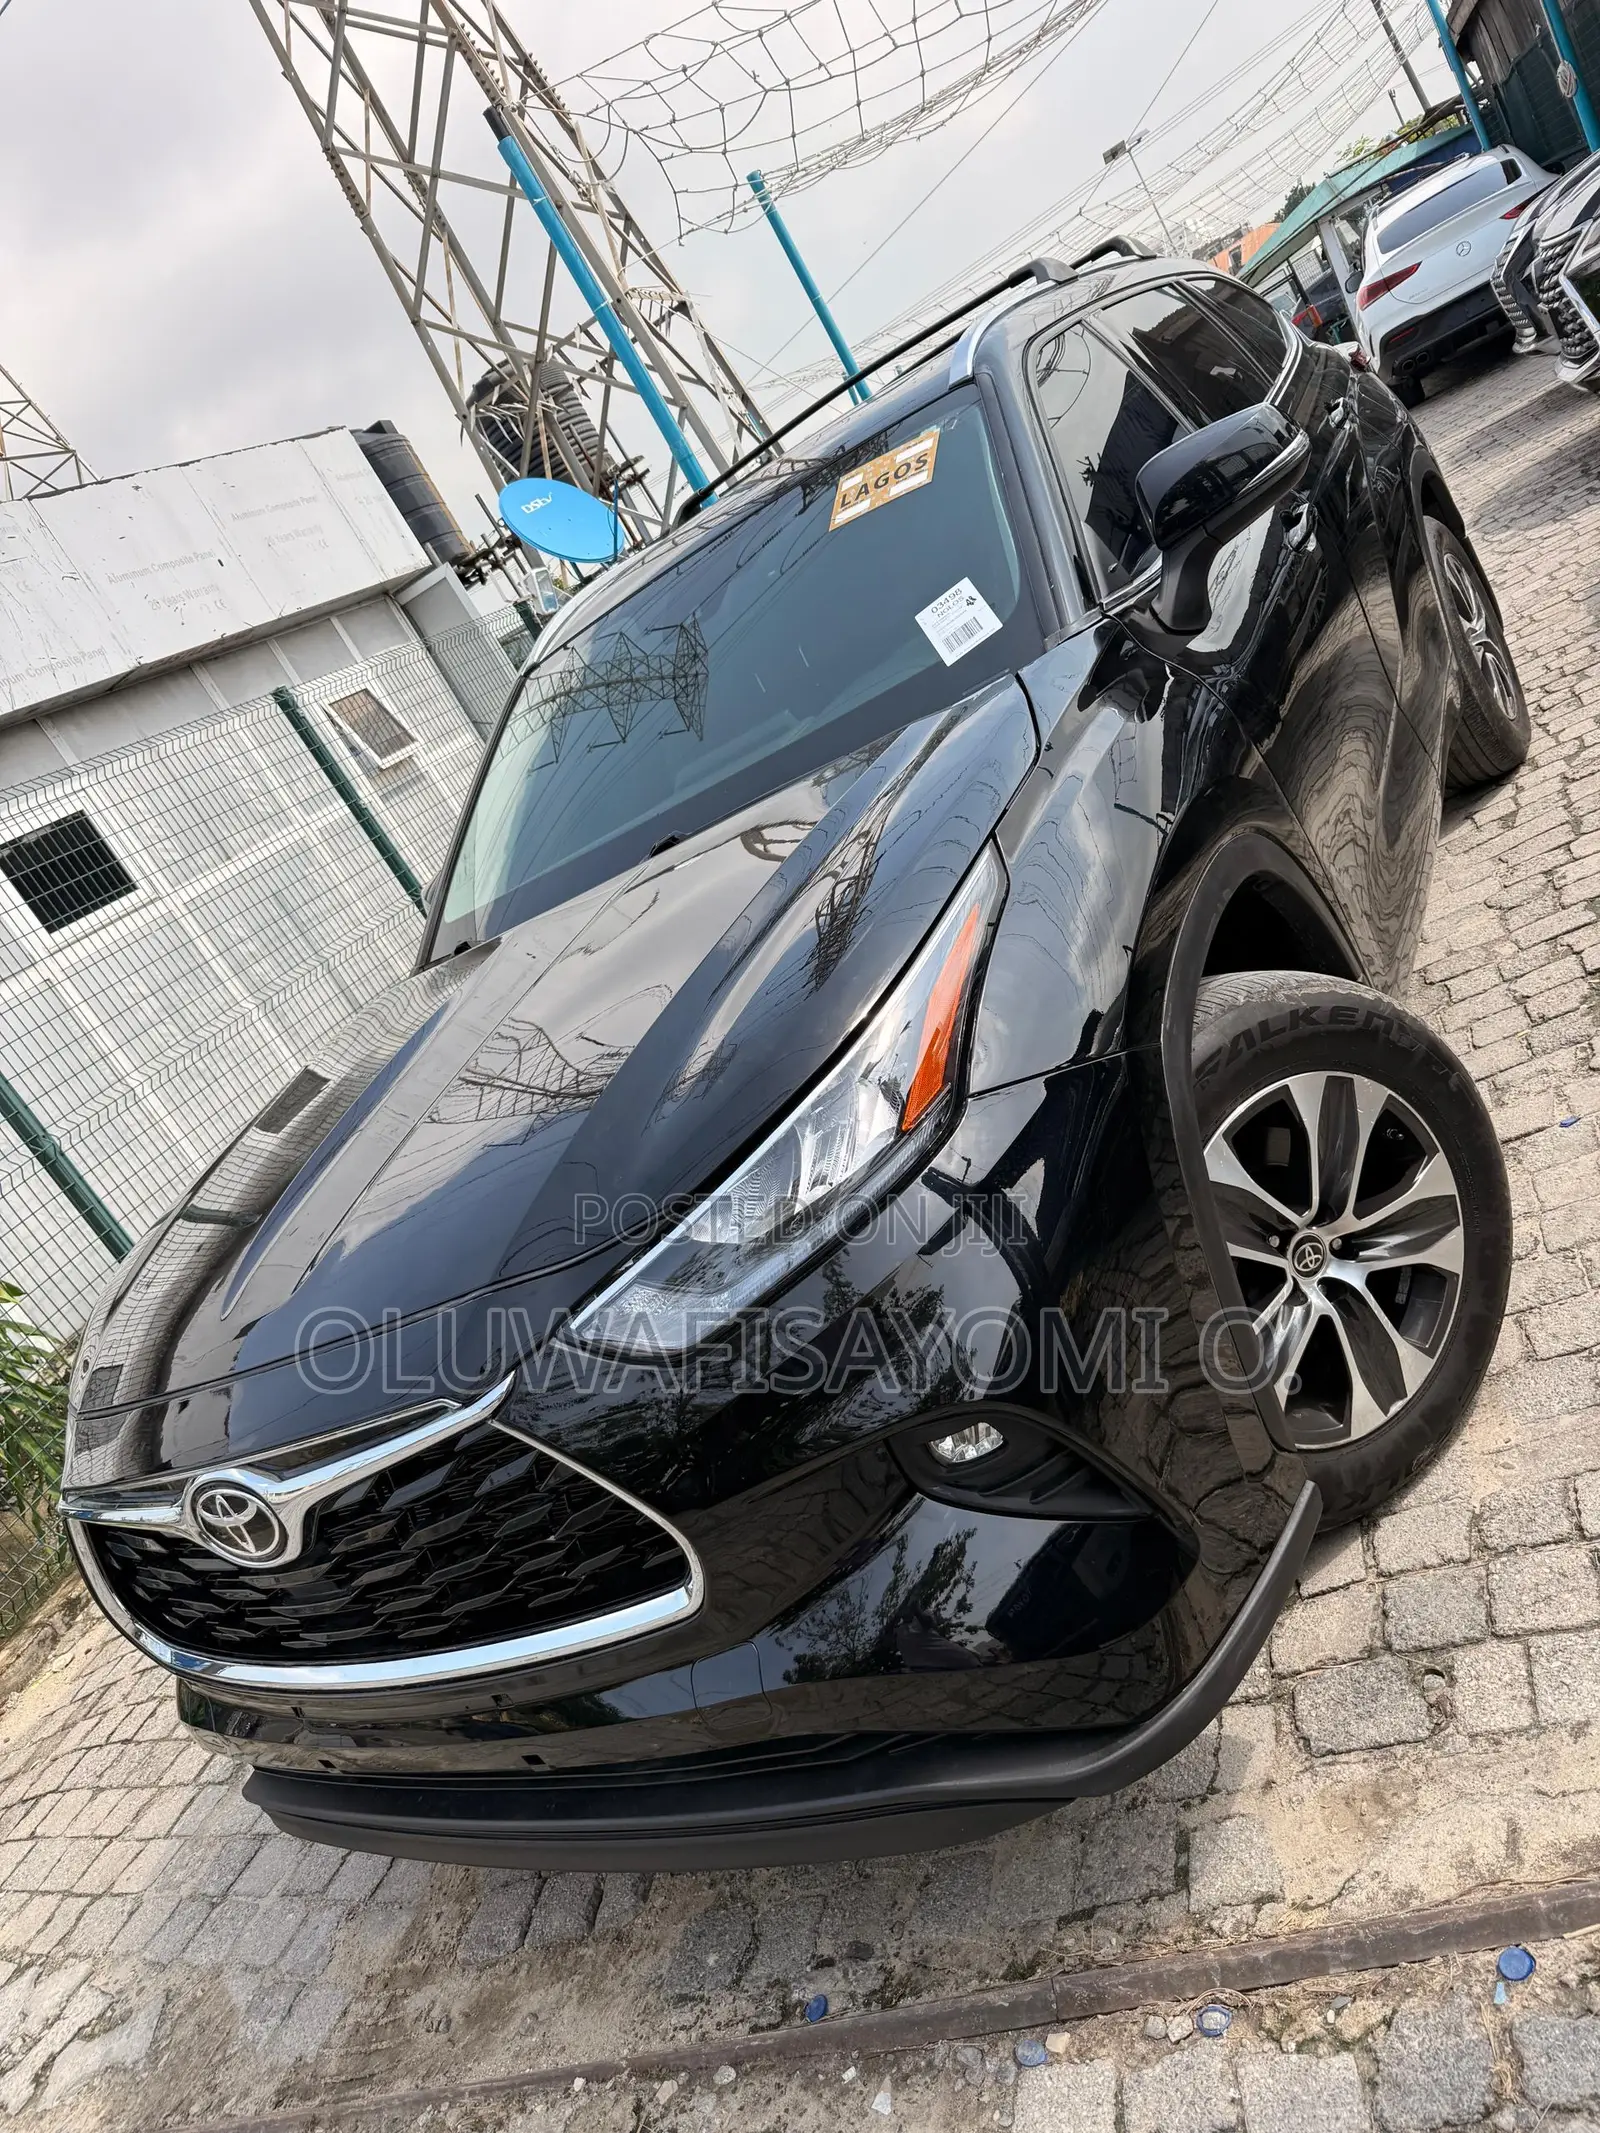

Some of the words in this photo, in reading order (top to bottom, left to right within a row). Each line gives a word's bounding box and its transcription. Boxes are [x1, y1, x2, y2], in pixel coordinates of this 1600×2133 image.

[839, 453, 929, 509] LAGOS
[105, 567, 152, 584] Aluminum
[150, 554, 195, 573] Composite
[192, 549, 216, 564] Panel
[162, 592, 182, 608] Years
[931, 588, 963, 614] 03498
[26, 655, 81, 678] Composite
[79, 647, 106, 665] Panel
